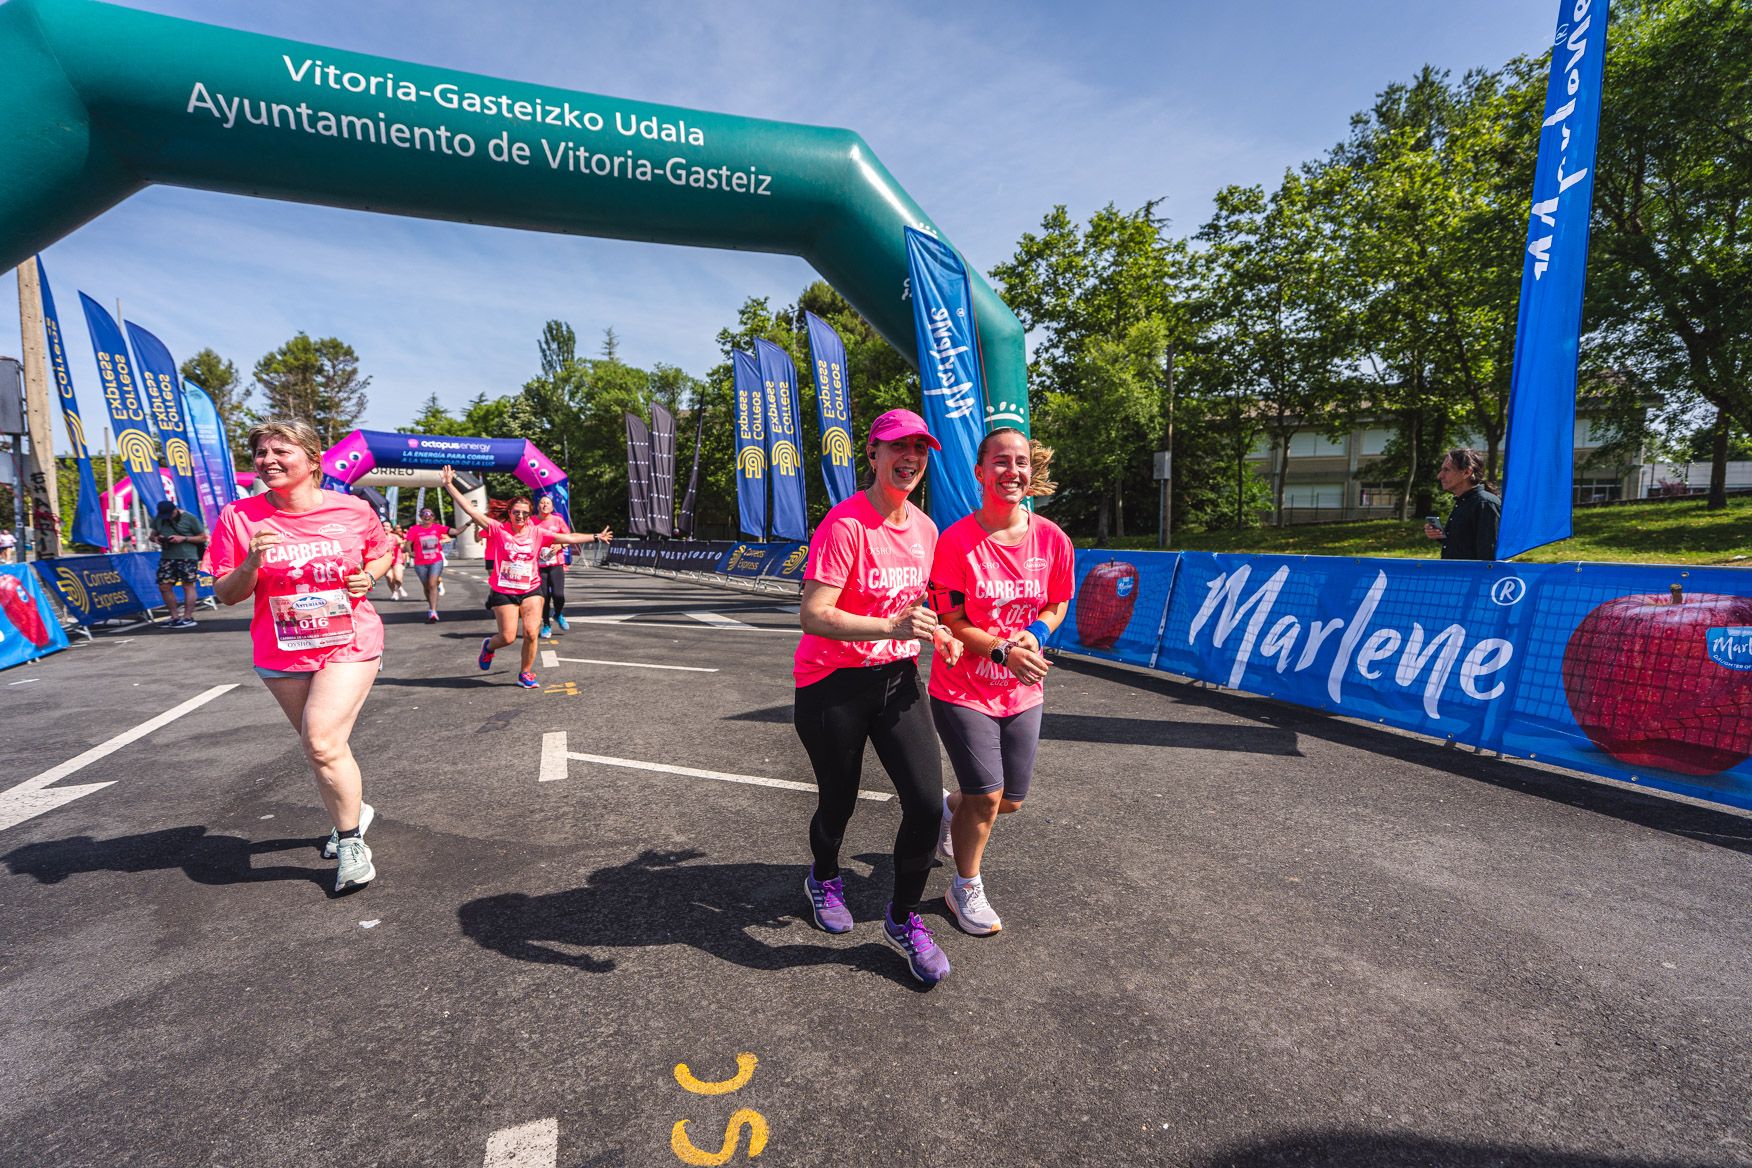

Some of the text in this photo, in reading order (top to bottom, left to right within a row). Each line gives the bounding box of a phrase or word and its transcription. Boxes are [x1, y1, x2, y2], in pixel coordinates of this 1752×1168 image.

[281, 53, 705, 146] Vitoria-Gasteizko Udala
[187, 82, 773, 195] Ayuntamiento de Vitoria-Gasteiz
[413, 450, 446, 458] ENERGÍA
[370, 467, 415, 476] ORREO
[266, 540, 342, 563] CARRERA
[628, 549, 656, 558] VOLVO
[660, 551, 687, 560] VOLVO
[687, 550, 723, 560] VOLVO
[83, 569, 121, 588] Correos
[867, 566, 924, 589] CARRERA
[91, 589, 129, 609] Express
[975, 579, 1041, 599] CARRERA
[1188, 564, 1514, 719] Marlene
[975, 656, 1017, 680] MUJ
